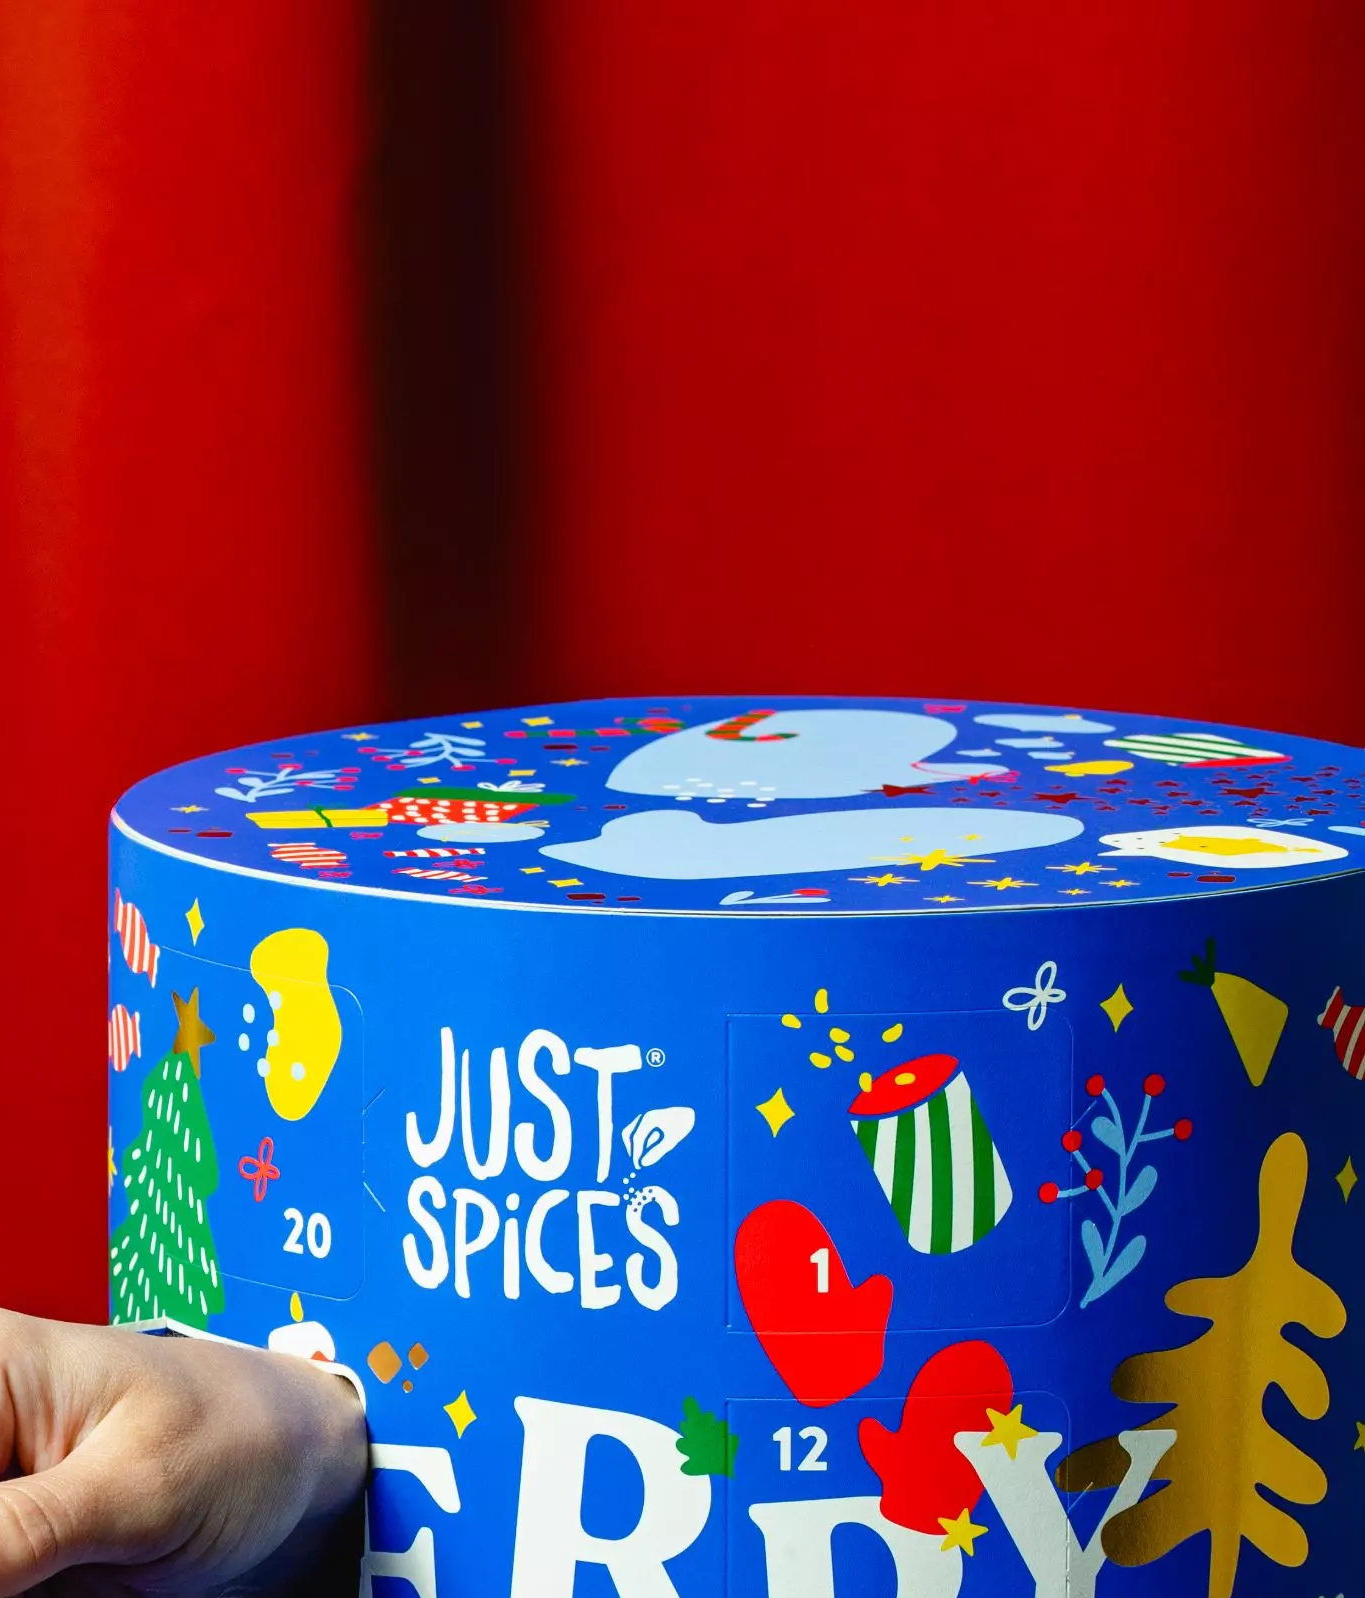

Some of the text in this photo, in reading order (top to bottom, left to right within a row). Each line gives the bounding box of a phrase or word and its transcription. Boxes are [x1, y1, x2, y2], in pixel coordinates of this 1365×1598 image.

[282, 1207, 332, 1259] 20
[809, 1247, 830, 1293] 1
[772, 1426, 829, 1471] 12
